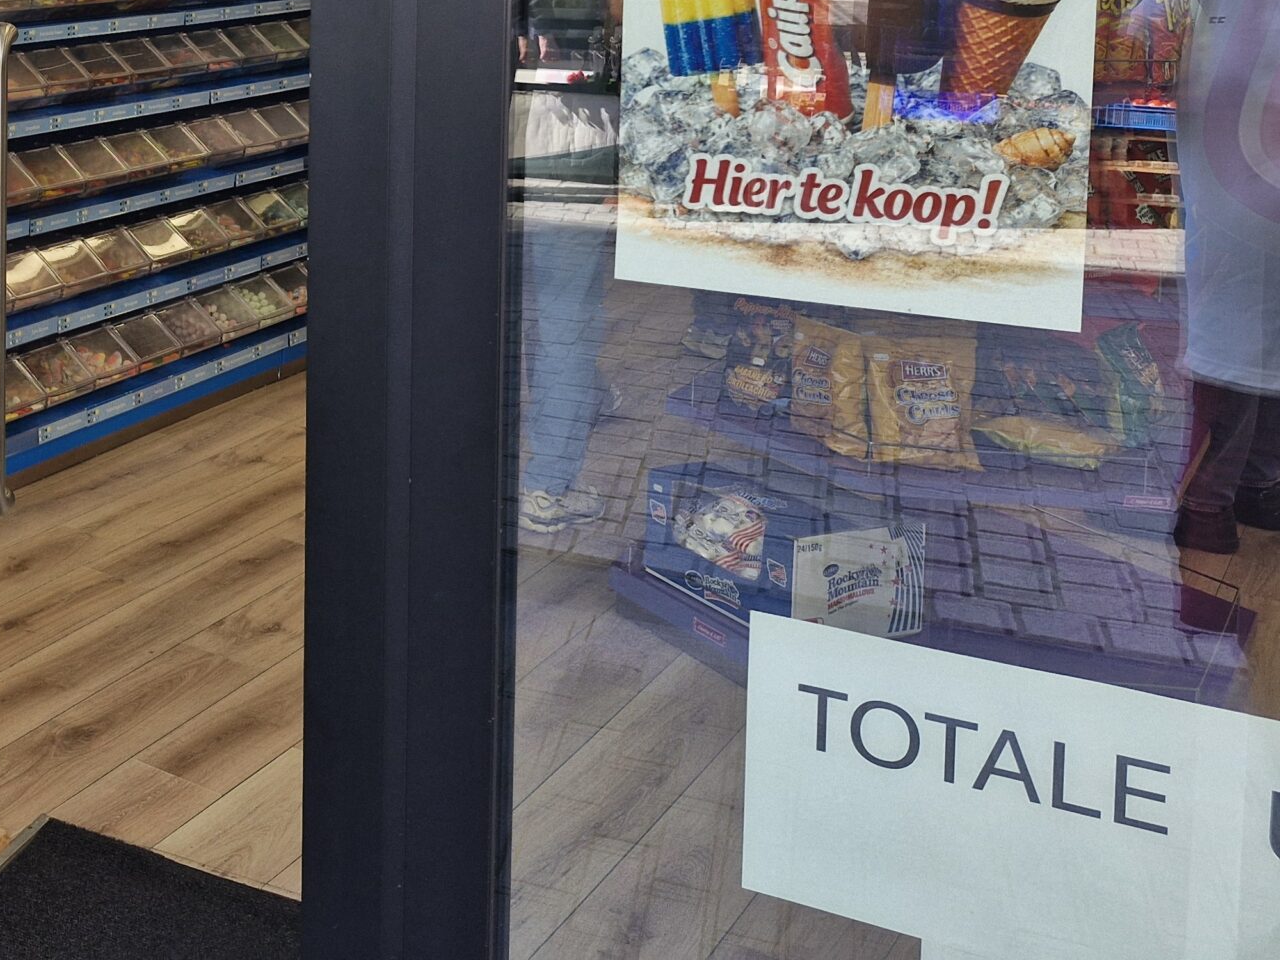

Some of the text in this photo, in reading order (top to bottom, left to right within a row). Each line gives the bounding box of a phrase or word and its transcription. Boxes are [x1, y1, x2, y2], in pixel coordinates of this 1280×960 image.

[688, 157, 1003, 241] Hier te koop!
[904, 364, 943, 378] HERR'S
[895, 385, 958, 405] Cheese
[906, 401, 961, 424] Curls
[827, 578, 880, 602] Mountain
[798, 683, 1171, 835] TOTALE
